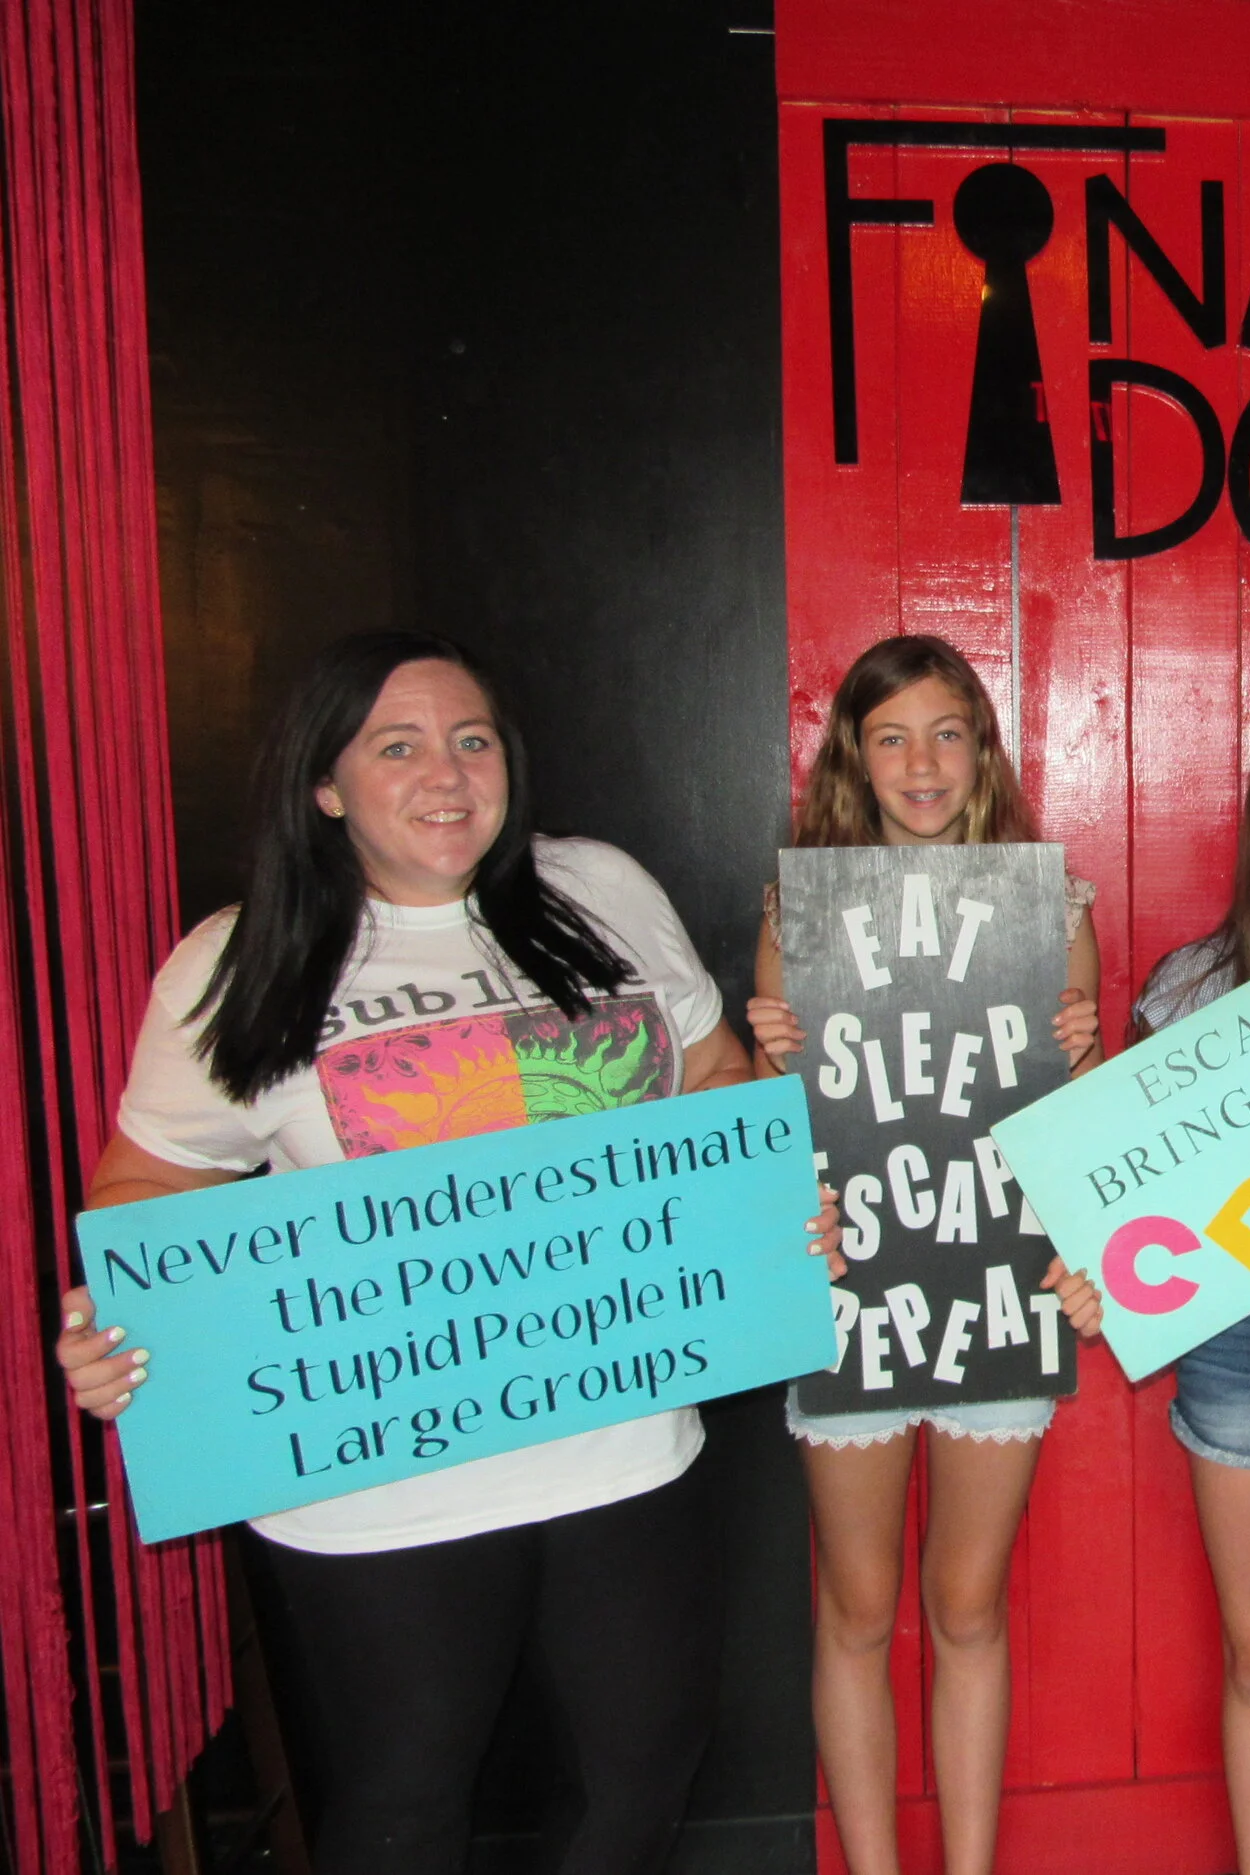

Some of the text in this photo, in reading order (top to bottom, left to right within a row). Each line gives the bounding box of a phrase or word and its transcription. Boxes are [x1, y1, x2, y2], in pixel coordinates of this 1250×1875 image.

[841, 873, 995, 991] EAT
[819, 1005, 1027, 1122] SLEEP
[104, 1117, 790, 1295] Never Underestimate
[270, 1197, 678, 1333] the Power of
[813, 1136, 1047, 1261] SCAP
[248, 1267, 725, 1415] Stupid People in
[290, 1339, 708, 1477] Large Groups
